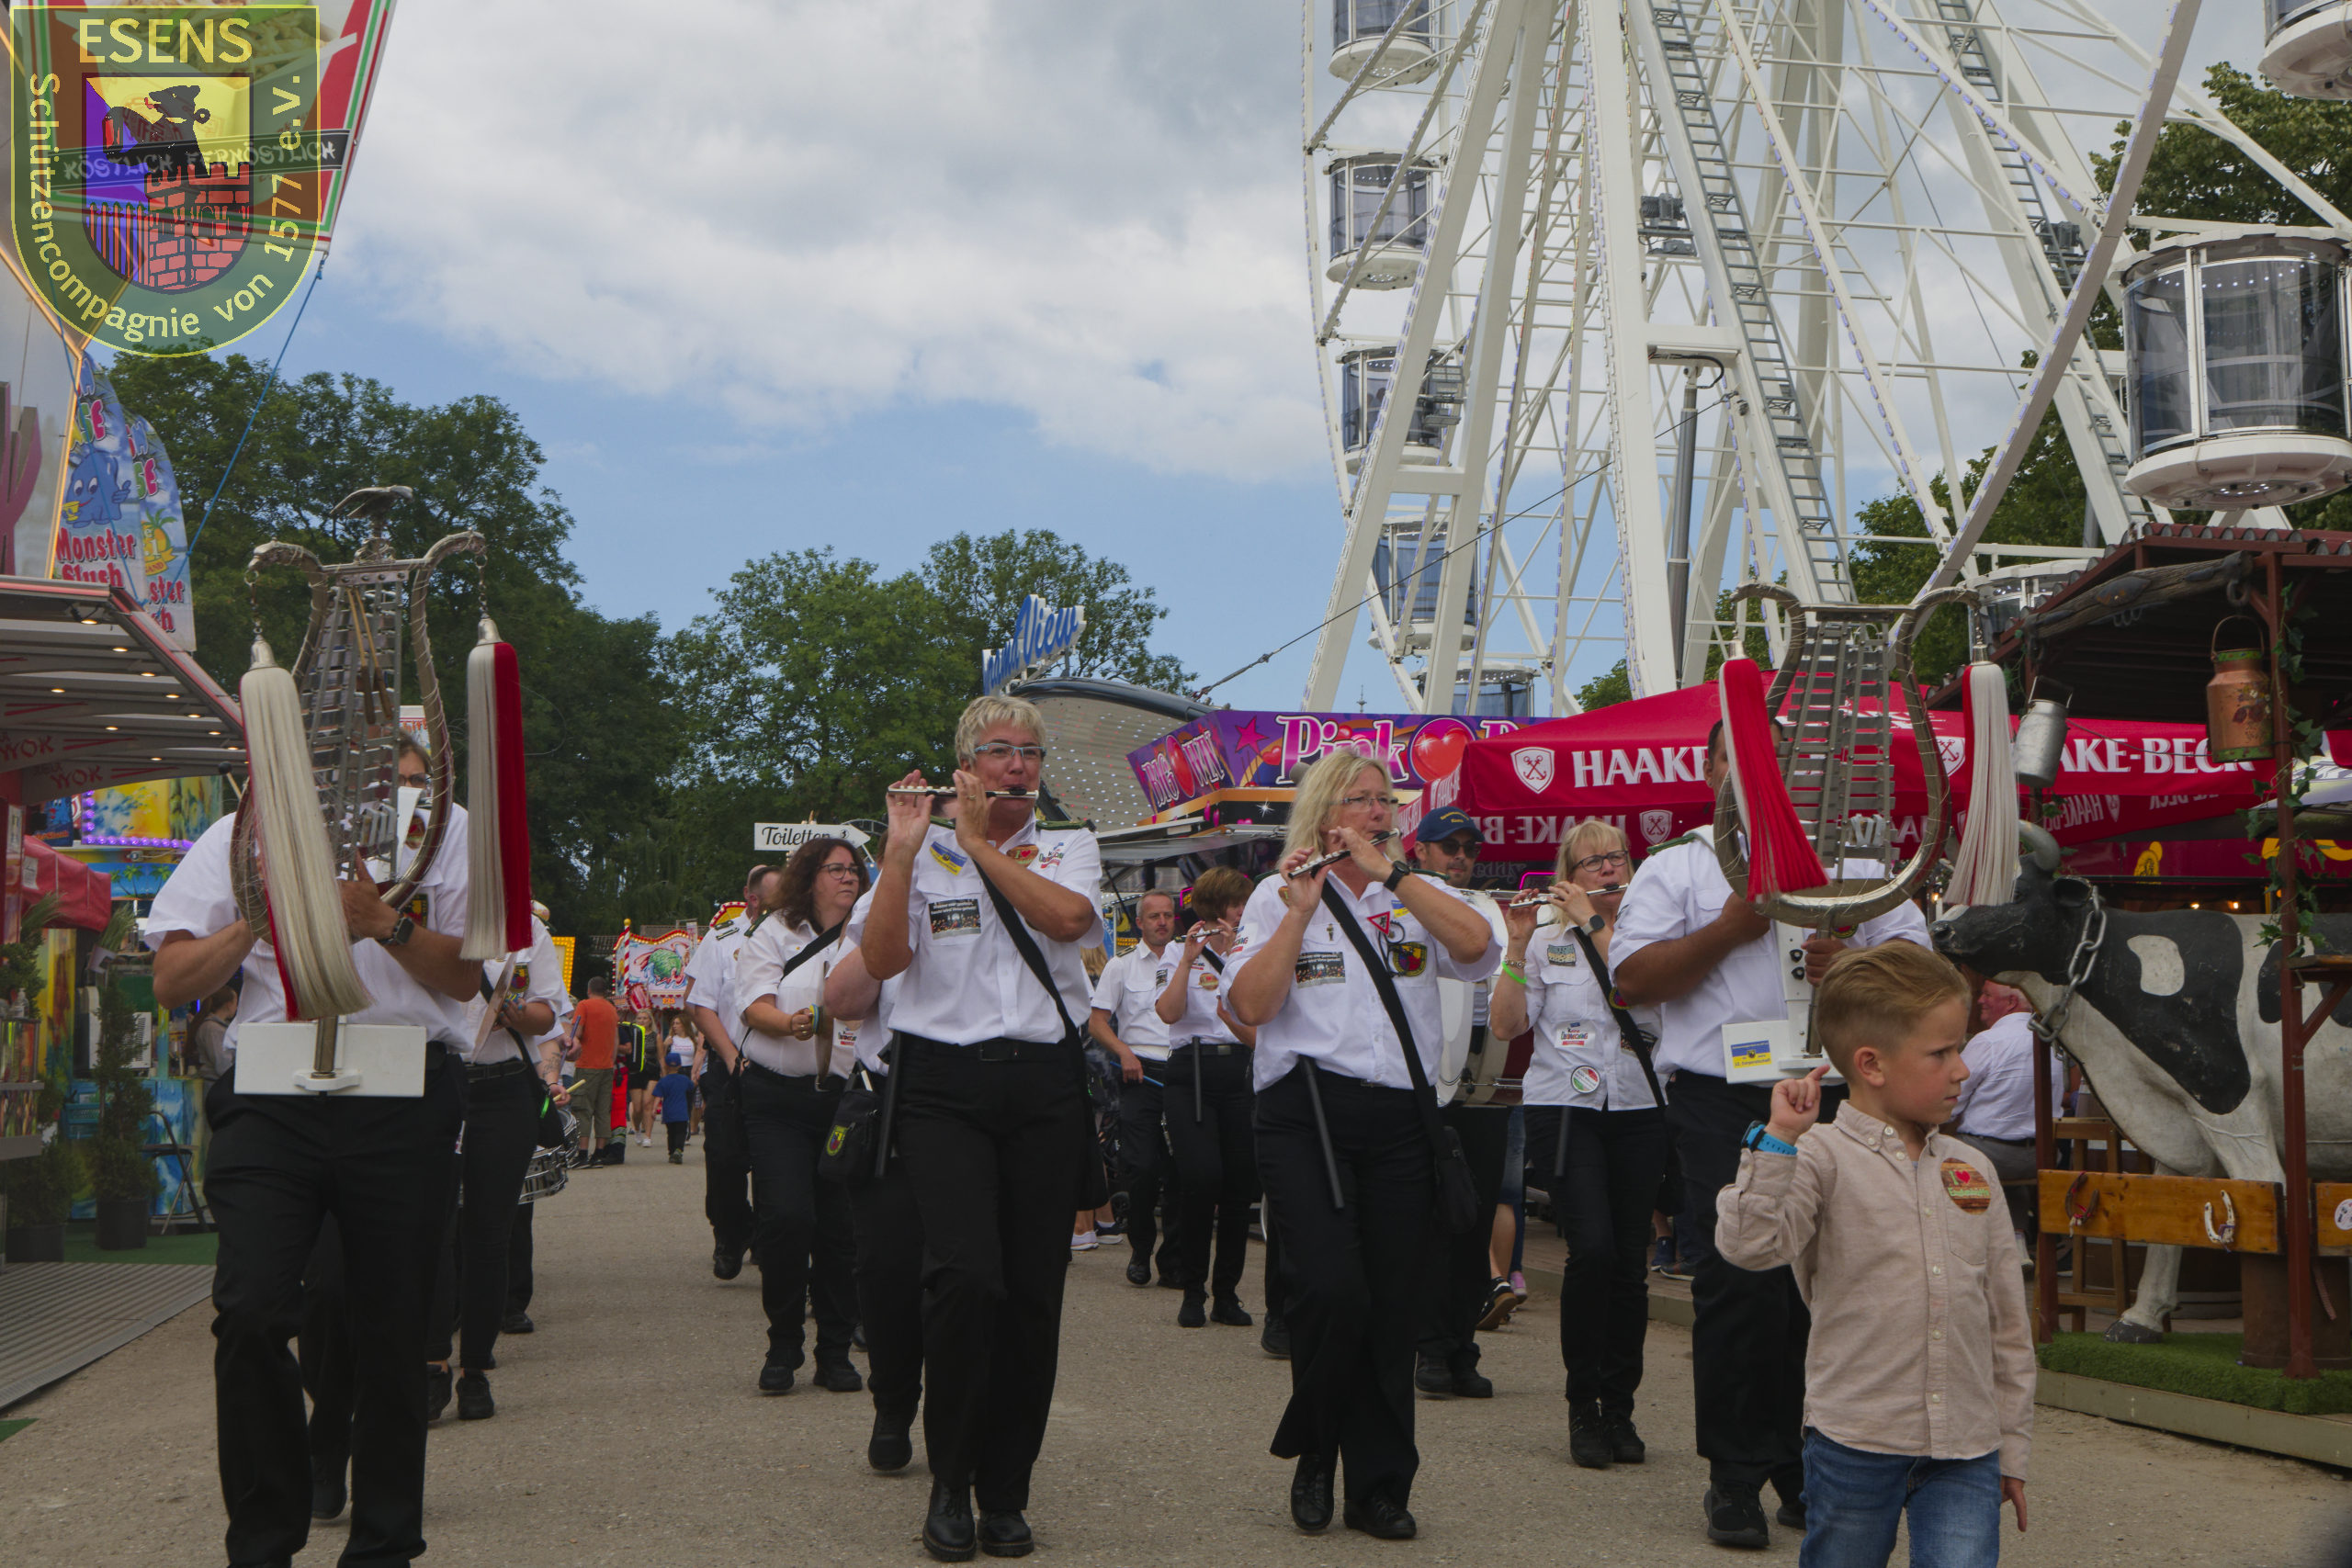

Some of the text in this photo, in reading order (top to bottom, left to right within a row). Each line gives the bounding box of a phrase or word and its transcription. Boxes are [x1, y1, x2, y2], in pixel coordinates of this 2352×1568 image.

[55, 527, 136, 563] Monster
[1014, 594, 1080, 666] View
[1141, 729, 1226, 807] BIG WIN
